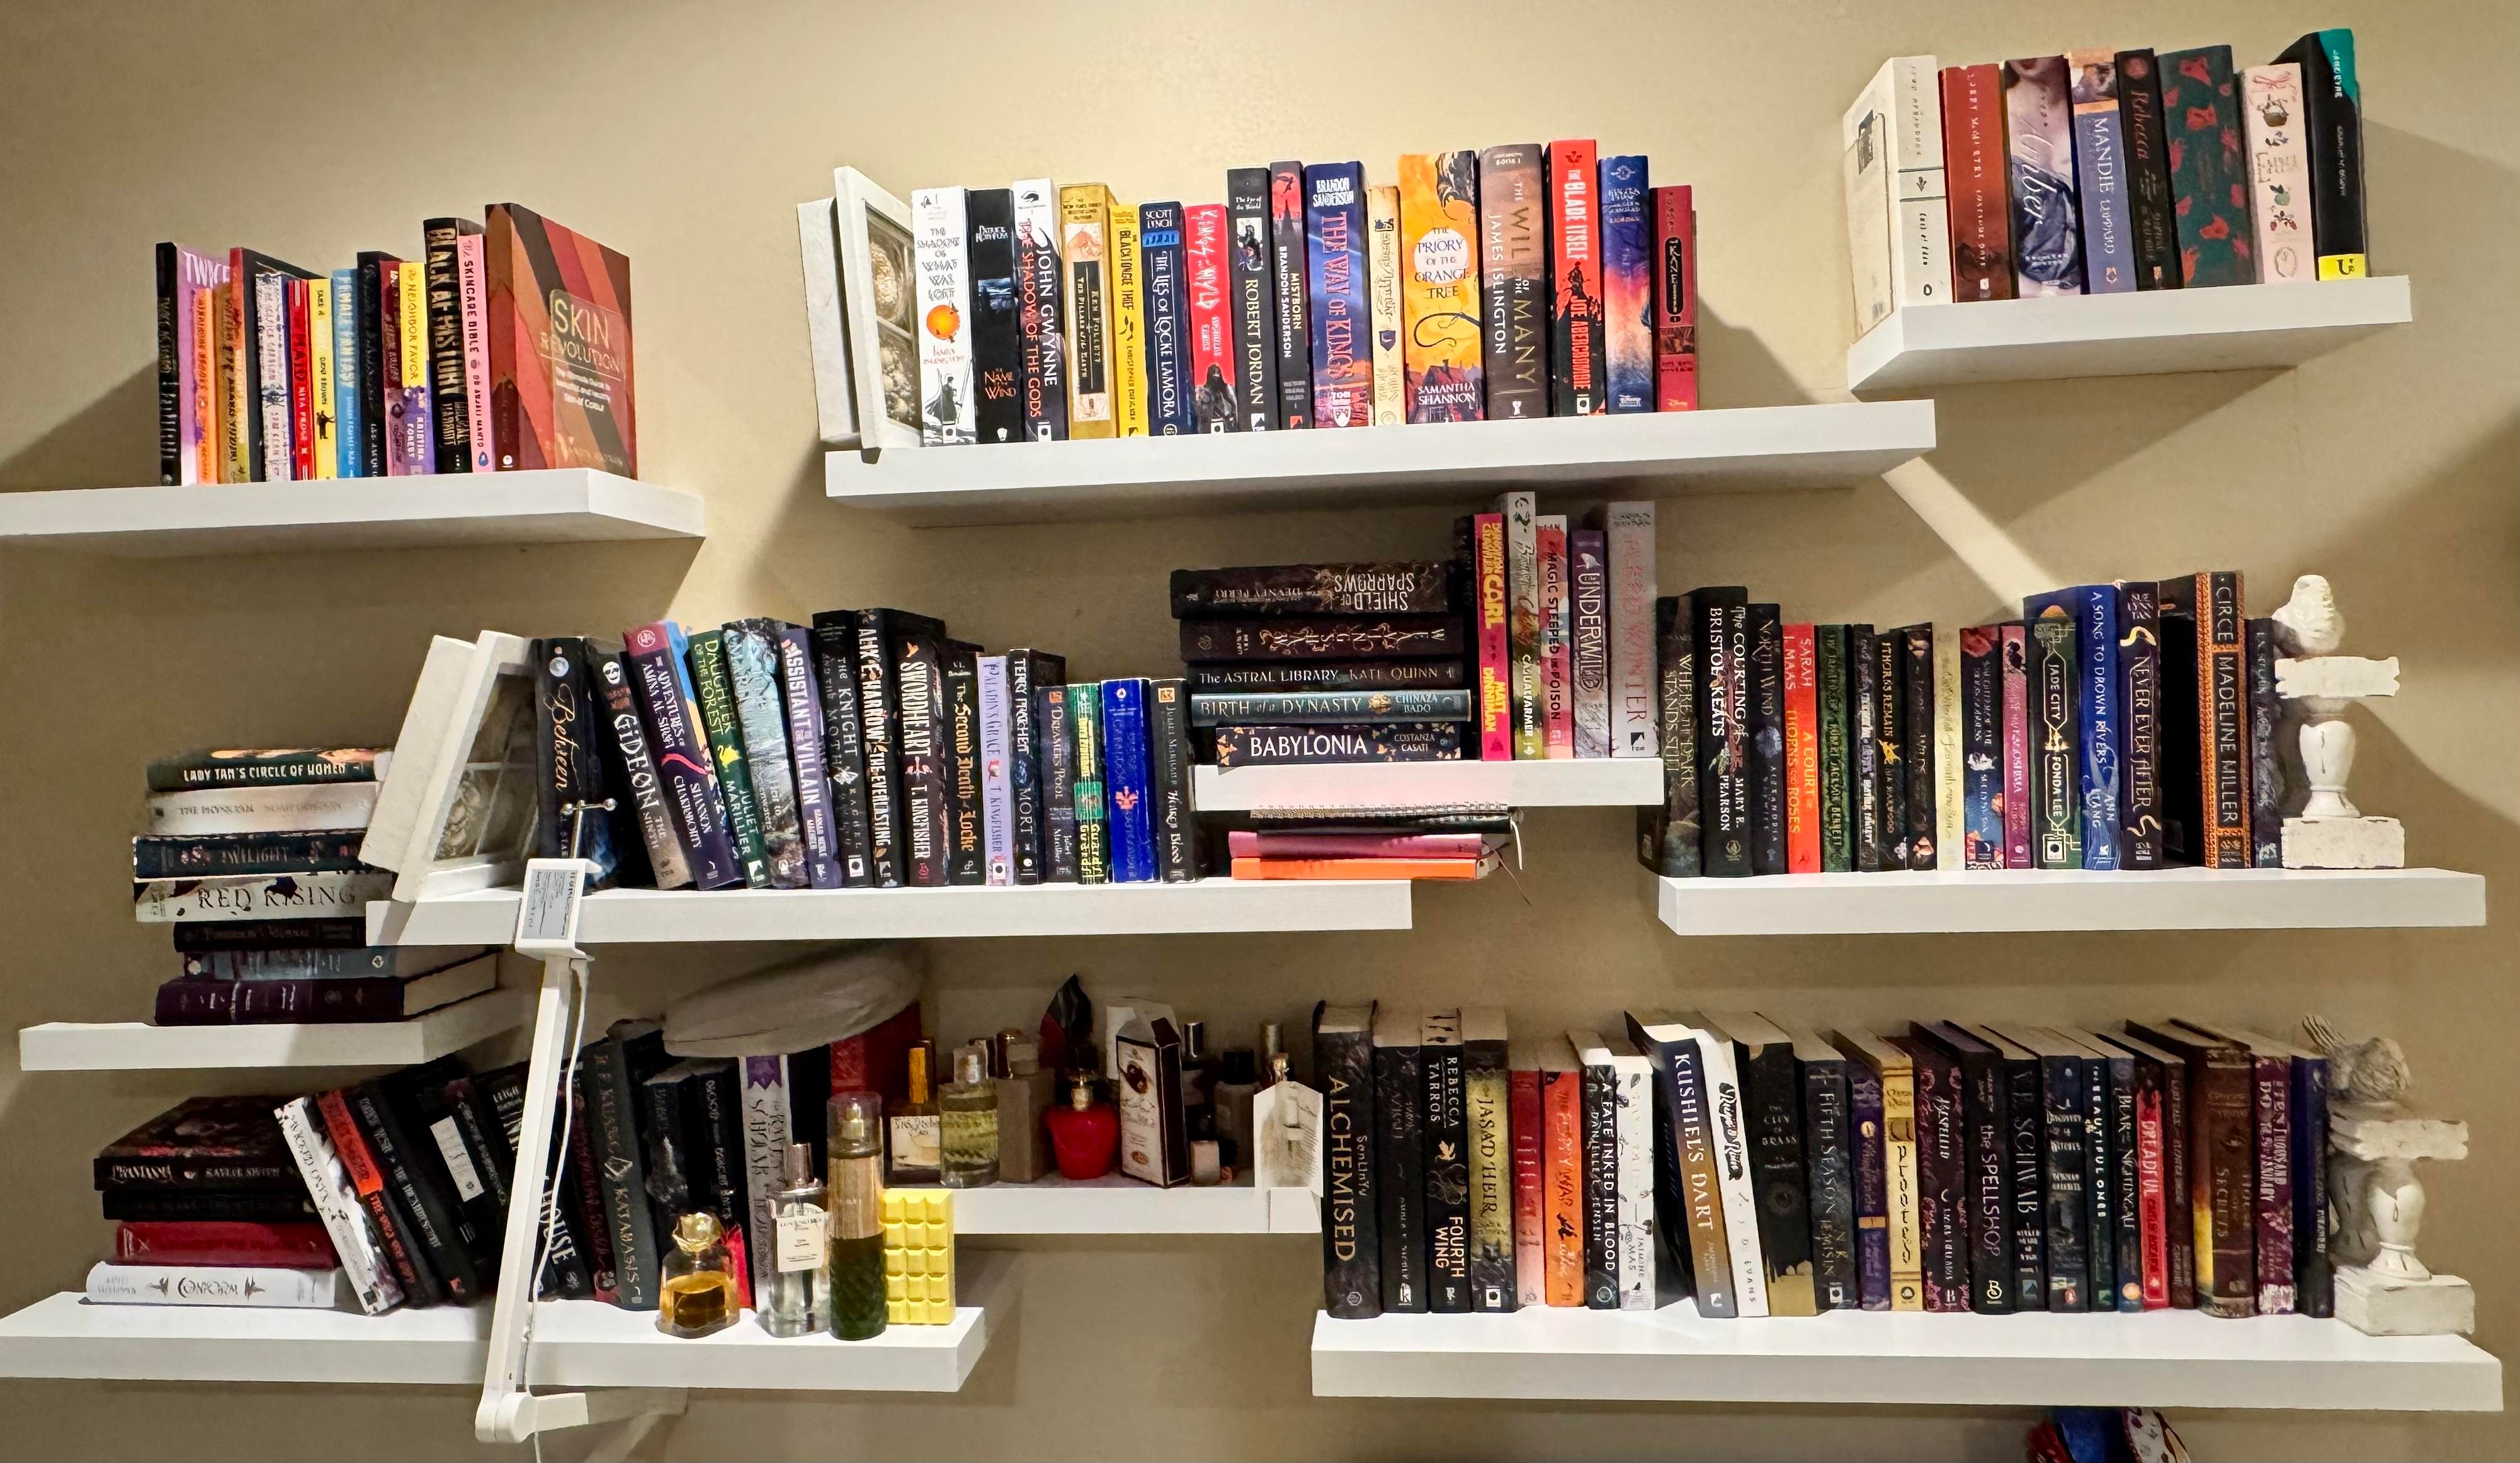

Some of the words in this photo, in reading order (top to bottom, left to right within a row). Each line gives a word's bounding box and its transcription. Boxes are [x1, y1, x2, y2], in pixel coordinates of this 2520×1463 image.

[2128, 91, 2151, 162] Rebecca
[2093, 117, 2114, 191] MANDIE
[1514, 182, 1523, 202] THE
[1564, 182, 1585, 222] BLADE
[1322, 212, 1348, 253] THE
[1417, 238, 1463, 253] PRIORY
[1488, 215, 1504, 261] JAMES
[1566, 225, 1587, 260] ITSELF
[464, 261, 476, 317] SKINCARE
[1021, 252, 1038, 319] SHADOW
[1037, 249, 1053, 297] JOHN
[1279, 246, 1289, 295] BRANDON
[1325, 254, 1351, 297] WAY
[1415, 267, 1469, 283] ORANGE
[1427, 285, 1460, 299] TREE
[409, 285, 419, 342] NEIGHBOR
[554, 298, 609, 349] SKIN
[1244, 280, 1261, 338] ROBERT
[1290, 273, 1302, 329] MISTBORN
[1492, 268, 1507, 355] ISLINGTON
[1570, 296, 1587, 317] JOE
[468, 322, 479, 353] BIBLE
[1026, 323, 1036, 342] OF
[1043, 304, 1058, 387] GWYNNE
[1156, 316, 1173, 356] LOCKE
[1281, 298, 1292, 358] SANDERSON
[1325, 318, 1354, 379] KINGS
[1513, 299, 1539, 384] MANY
[410, 346, 419, 380] FAVOR
[434, 315, 467, 396] HISTORY
[1028, 345, 1039, 374] THE
[1246, 342, 1264, 405] JORDAN
[1572, 321, 1591, 390] ABERCROMBIE
[1029, 378, 1043, 418] GODS
[1161, 361, 1175, 418] LAMORA
[1417, 383, 1475, 394] SAMANTHA
[1418, 392, 1476, 405] SHANNON
[1334, 572, 1415, 593] SPARROWS
[1547, 552, 1559, 593] MAGIC
[1354, 591, 1408, 612] SHIELD
[1483, 574, 1505, 629] CARL
[1730, 606, 1747, 629] The
[2092, 592, 2104, 602] A
[2216, 586, 2235, 641] CIRCE
[858, 629, 880, 658] ALIX
[1547, 598, 1560, 654] STEEPED
[1578, 572, 1602, 693] UNDERWILD
[1710, 607, 1725, 676] BRISTOL
[2091, 605, 2104, 640] SONG
[837, 657, 848, 679] THE
[1013, 657, 1028, 694] TERRY
[1200, 673, 1220, 684] The
[1224, 671, 1276, 684] ASTRAL
[1281, 669, 1339, 681] LIBRARY
[1349, 668, 1382, 681] KATE
[1390, 666, 1438, 680] QUINN
[1733, 632, 1747, 719] COURTING
[1785, 649, 1796, 690] MAAS
[1800, 637, 1813, 686] SARAH
[2050, 663, 2061, 690] JADE
[2093, 645, 2105, 662] TO
[705, 639, 734, 734] DAUGHTER
[785, 647, 811, 727] ASSISTANT
[1201, 698, 1250, 716] BIRTH
[1283, 696, 1362, 714] DYNASTY
[1483, 667, 1497, 732] DINNIMAN
[1495, 681, 1506, 714] MATT
[1549, 671, 1561, 720] POISON
[1664, 670, 1679, 730] STANDS
[1679, 653, 1693, 714] WHERE
[1761, 676, 1776, 715] WIND
[2051, 693, 2061, 720] CITY
[2094, 667, 2107, 715] DROWN
[2131, 656, 2152, 709] NEVER
[2217, 656, 2236, 752] MADELINE
[701, 680, 724, 735] FOREST
[837, 688, 858, 756] KNIGHT
[861, 680, 885, 739] HARROW
[900, 661, 931, 757] SWORDHEART
[954, 703, 973, 754] Second
[1015, 697, 1030, 754] PRATCHETT
[1711, 687, 1726, 736] KEATS
[1883, 694, 1894, 737] REMAIN
[543, 683, 580, 792] Between
[827, 709, 843, 767] MOTH
[1249, 734, 1368, 758] BABYLONIA
[1393, 734, 1436, 743] COSTANZA
[1400, 743, 1428, 753] CASATI
[1787, 710, 1799, 766] THORNS
[1803, 731, 1814, 741] A
[2095, 720, 2110, 764] RIVERS
[2133, 714, 2151, 754] EVER
[184, 769, 211, 782] LADY
[249, 765, 287, 778] CIRCLE
[290, 765, 303, 777] OF
[307, 763, 346, 776] WOMEN
[795, 739, 822, 805] VILLAIN
[870, 752, 885, 773] THE
[956, 756, 975, 799] Death
[1053, 768, 1067, 799] POOL
[1681, 743, 1695, 788] DARK
[1803, 748, 1815, 794] COURT
[2052, 756, 2063, 794] FONDA
[2132, 758, 2151, 811] AFTER
[738, 790, 760, 834] JULIET
[871, 775, 892, 846] EVERLASTING
[1018, 787, 1033, 834] MORT
[1720, 774, 1731, 831] PEARSON
[1735, 778, 1745, 811] MARY
[1788, 787, 1801, 833] ROSES
[2053, 798, 2063, 817] LEE
[2104, 794, 2116, 821] ANN
[2221, 760, 2238, 823] MILLER
[655, 816, 667, 838] THE
[725, 780, 752, 856] MARILLIER
[911, 799, 931, 859] KINGFISHER
[959, 810, 977, 851] Locke
[989, 797, 1003, 852] KINGFISHER
[198, 886, 252, 910] RED
[1428, 1062, 1441, 1122] YARROS
[1446, 1057, 1460, 1127] REBECCA
[1601, 1082, 1613, 1093] A
[1674, 1053, 1705, 1163] KUSHIEL'S
[1476, 1099, 1498, 1158] JASAD
[1601, 1100, 1614, 1136] FATE
[1819, 1093, 1836, 1139] FIFTH
[1981, 1125, 1994, 1148] the
[2092, 1086, 2105, 1173] BEAUTIFUL
[1328, 1074, 1356, 1261] ALCHEMISED
[1603, 1142, 1615, 1191] INKED
[1820, 1145, 1838, 1214] SEASON
[2014, 1117, 2039, 1213] SCHWAB
[2141, 1120, 2159, 1195] DREADFUL
[1477, 1163, 1498, 1216] HEIR
[1604, 1197, 1615, 1214] IN
[1689, 1173, 1713, 1231] DART
[1982, 1153, 2002, 1256] SPELLSHOP
[615, 1188, 640, 1284] KATABASIS
[1434, 1226, 1449, 1268] WING
[1448, 1216, 1465, 1278] FOURTH
[1604, 1221, 1616, 1270] BLOOD
[1744, 1260, 1757, 1303] EVANS
